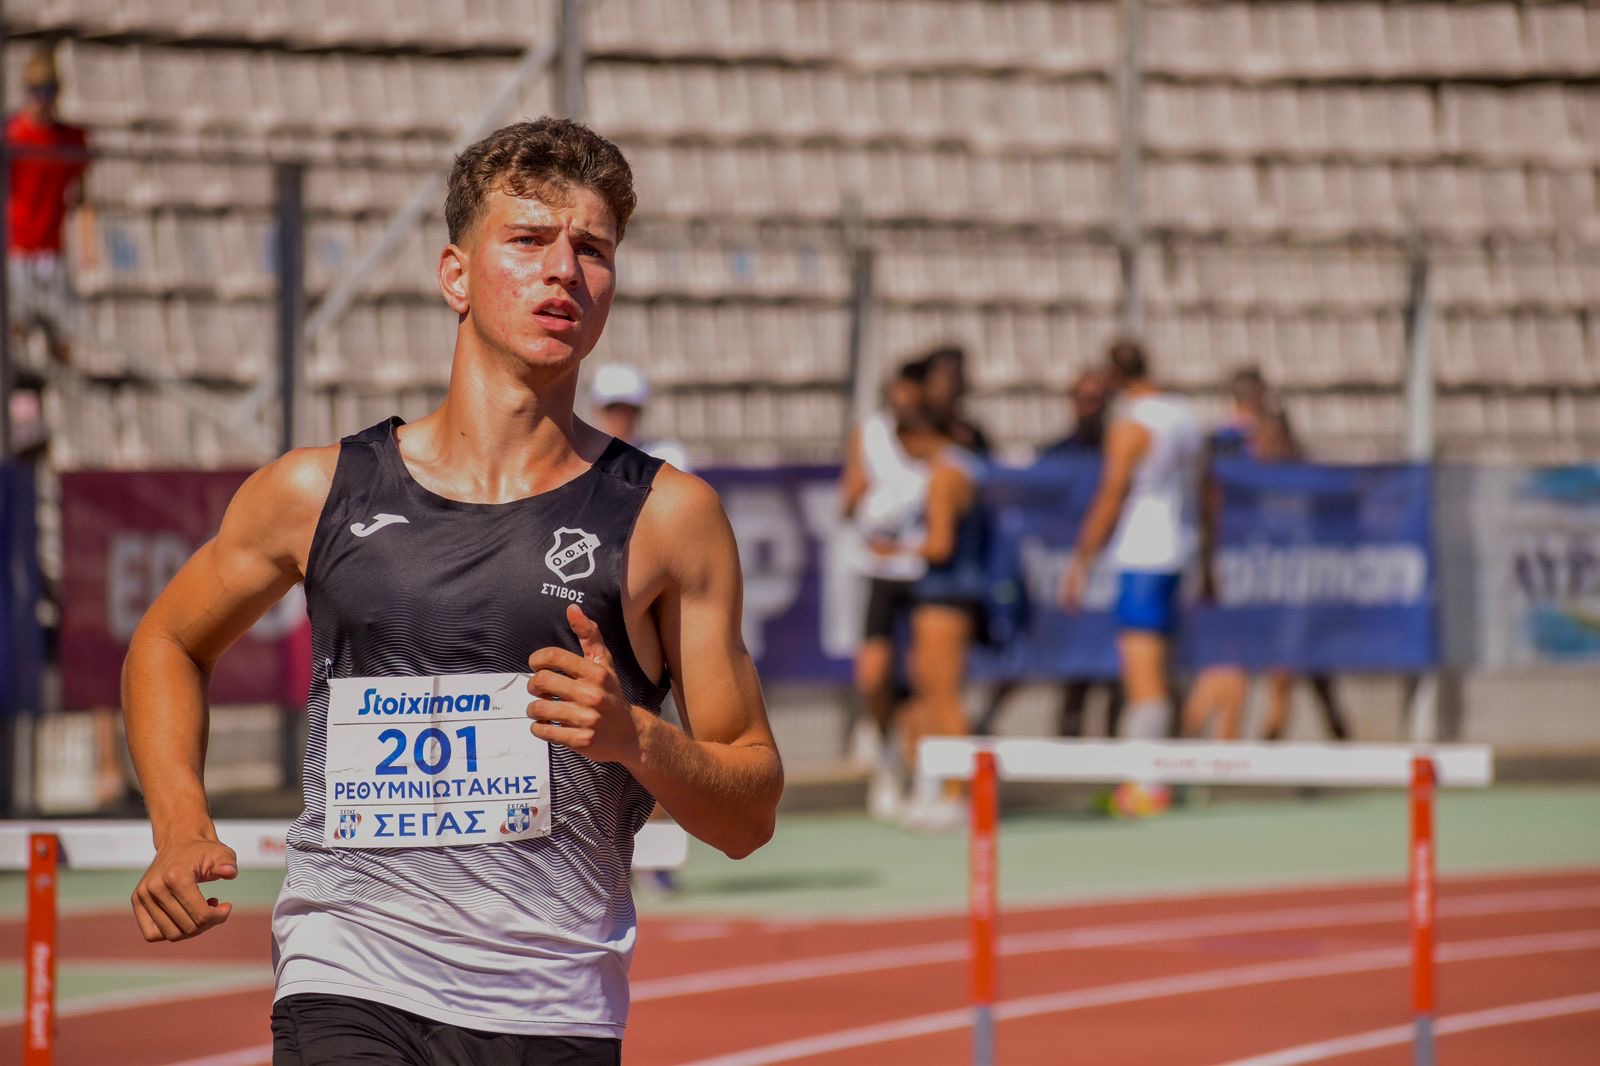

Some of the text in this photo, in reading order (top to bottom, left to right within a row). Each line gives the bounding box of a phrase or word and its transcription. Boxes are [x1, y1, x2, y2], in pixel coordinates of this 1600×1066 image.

[541, 583, 584, 603] ΣΤΙΒΟΣ
[358, 688, 491, 716] Stoiximan
[375, 725, 478, 776] 201
[334, 775, 538, 800] ΡΕΘΥΜΝΙΩΤΑΚΗΣ
[373, 810, 487, 838] ΣΕΓΑΣ
